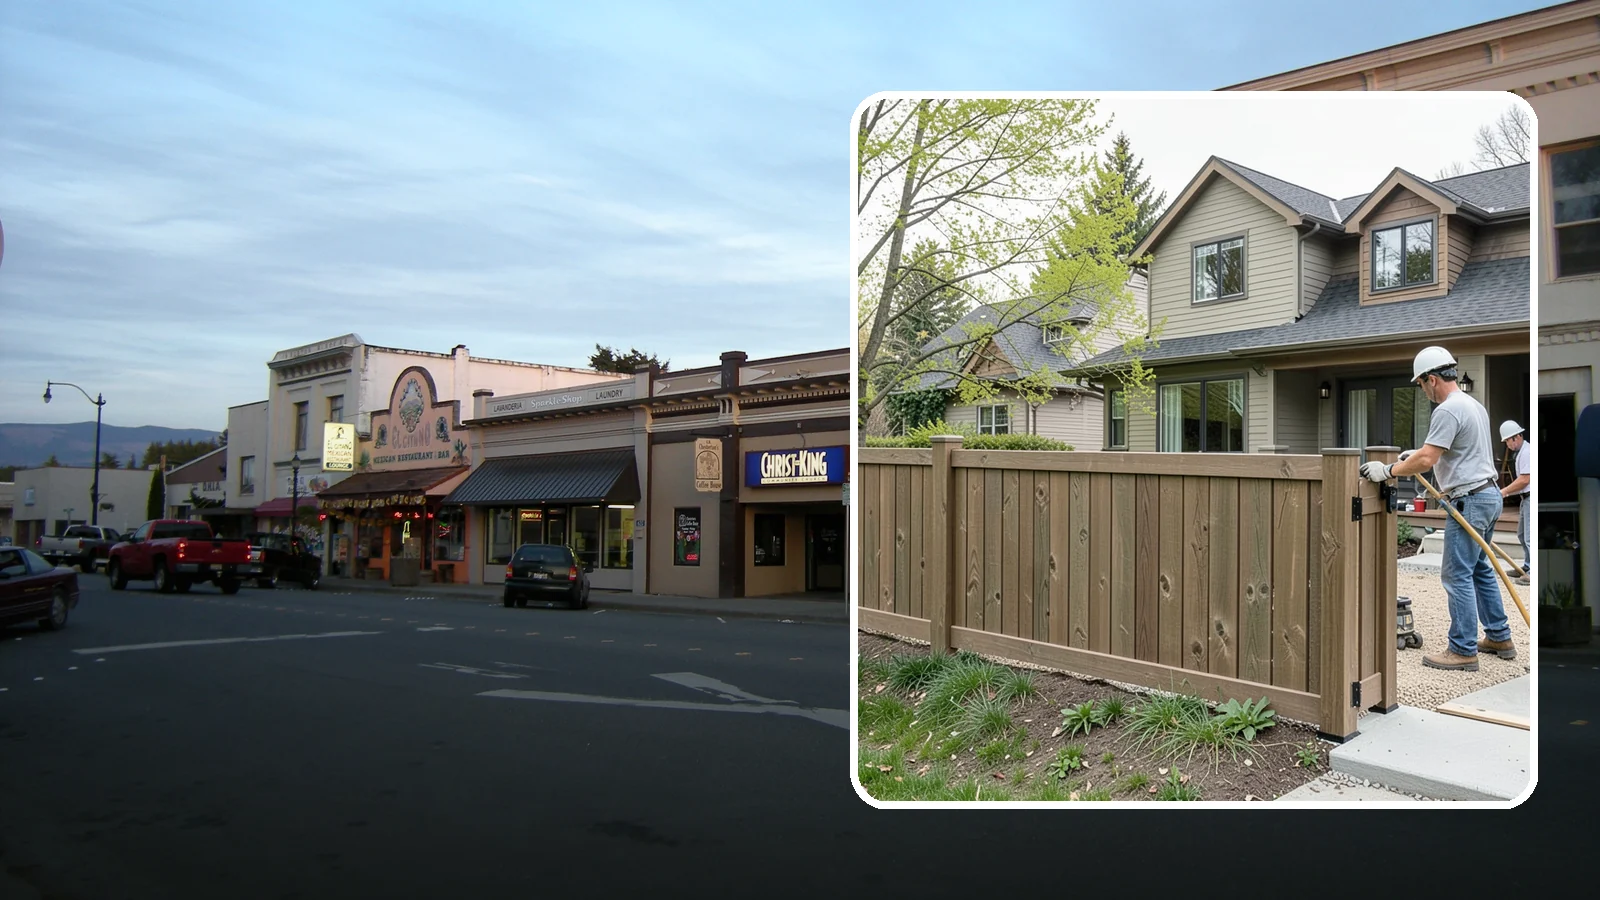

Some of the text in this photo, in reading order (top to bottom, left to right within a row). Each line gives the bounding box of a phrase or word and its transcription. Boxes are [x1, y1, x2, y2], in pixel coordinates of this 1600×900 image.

[595, 389, 623, 399] LAUNDRY
[562, 395, 582, 404] Shop
[493, 402, 522, 412] LAVANDERIA
[438, 450, 450, 459] BAR
[761, 450, 828, 478] CHRIST KING
